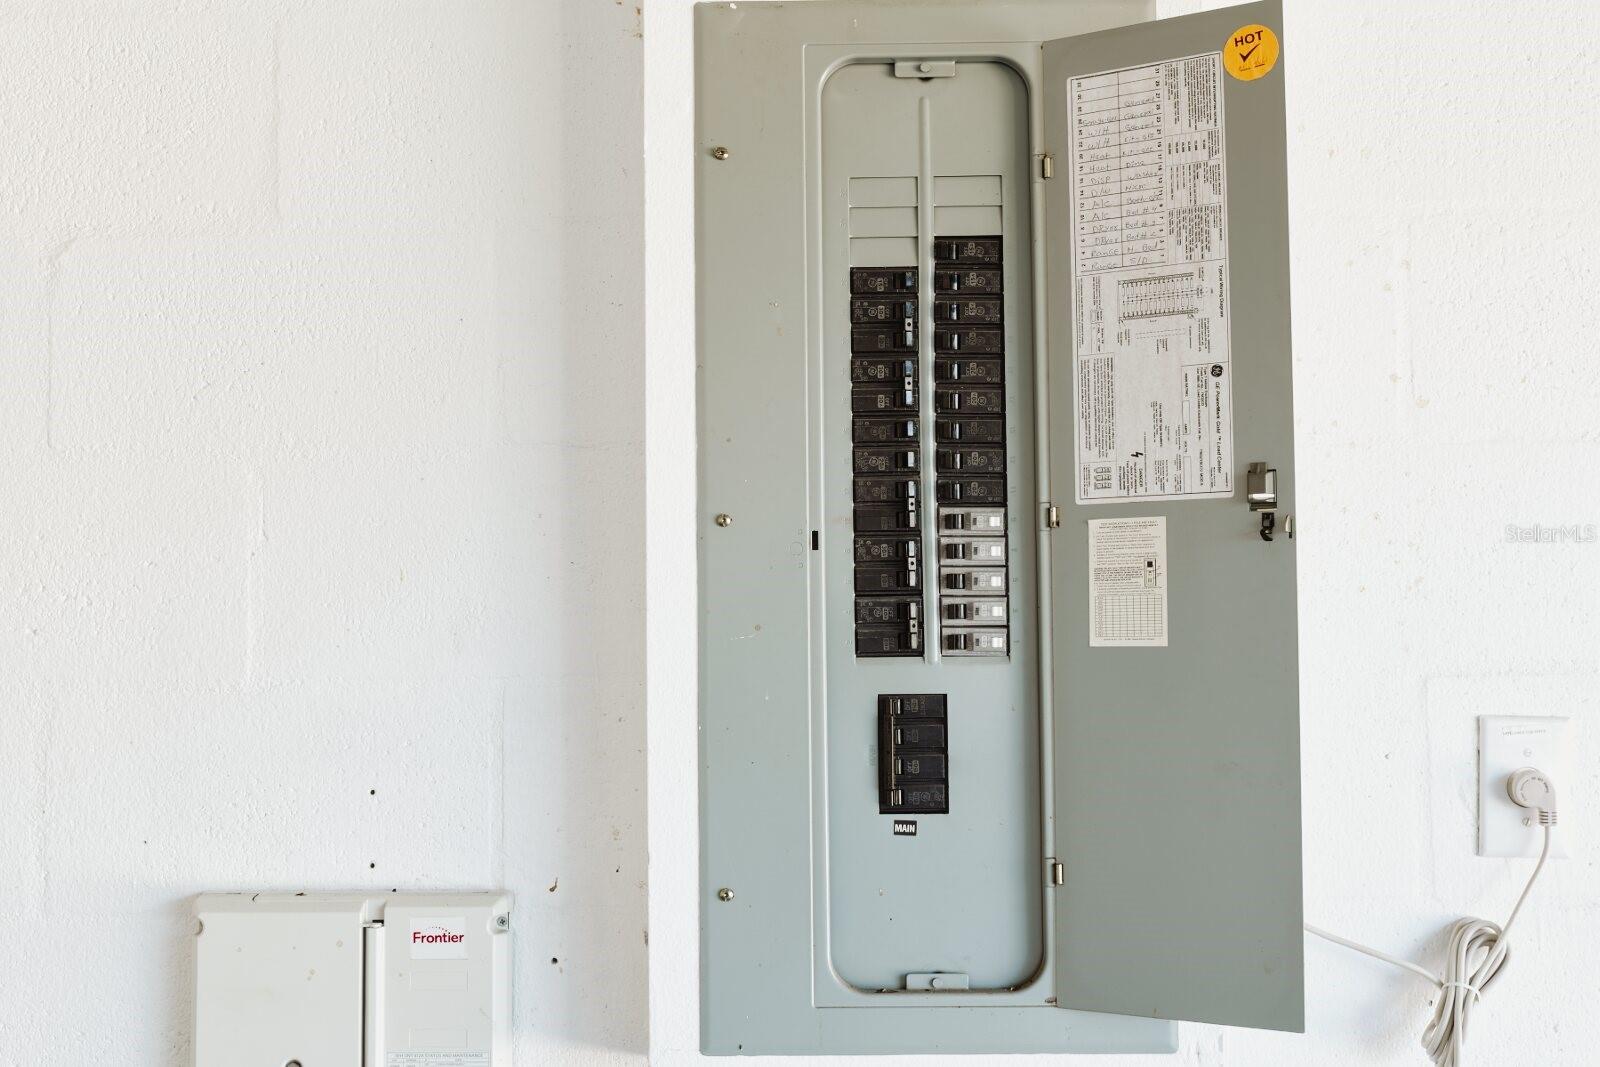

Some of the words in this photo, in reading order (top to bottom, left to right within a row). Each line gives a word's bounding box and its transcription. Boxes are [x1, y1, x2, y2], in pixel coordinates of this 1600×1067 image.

[1234, 30, 1263, 47] HOT
[895, 824, 915, 833] MAIN
[413, 931, 464, 944] Frontier
